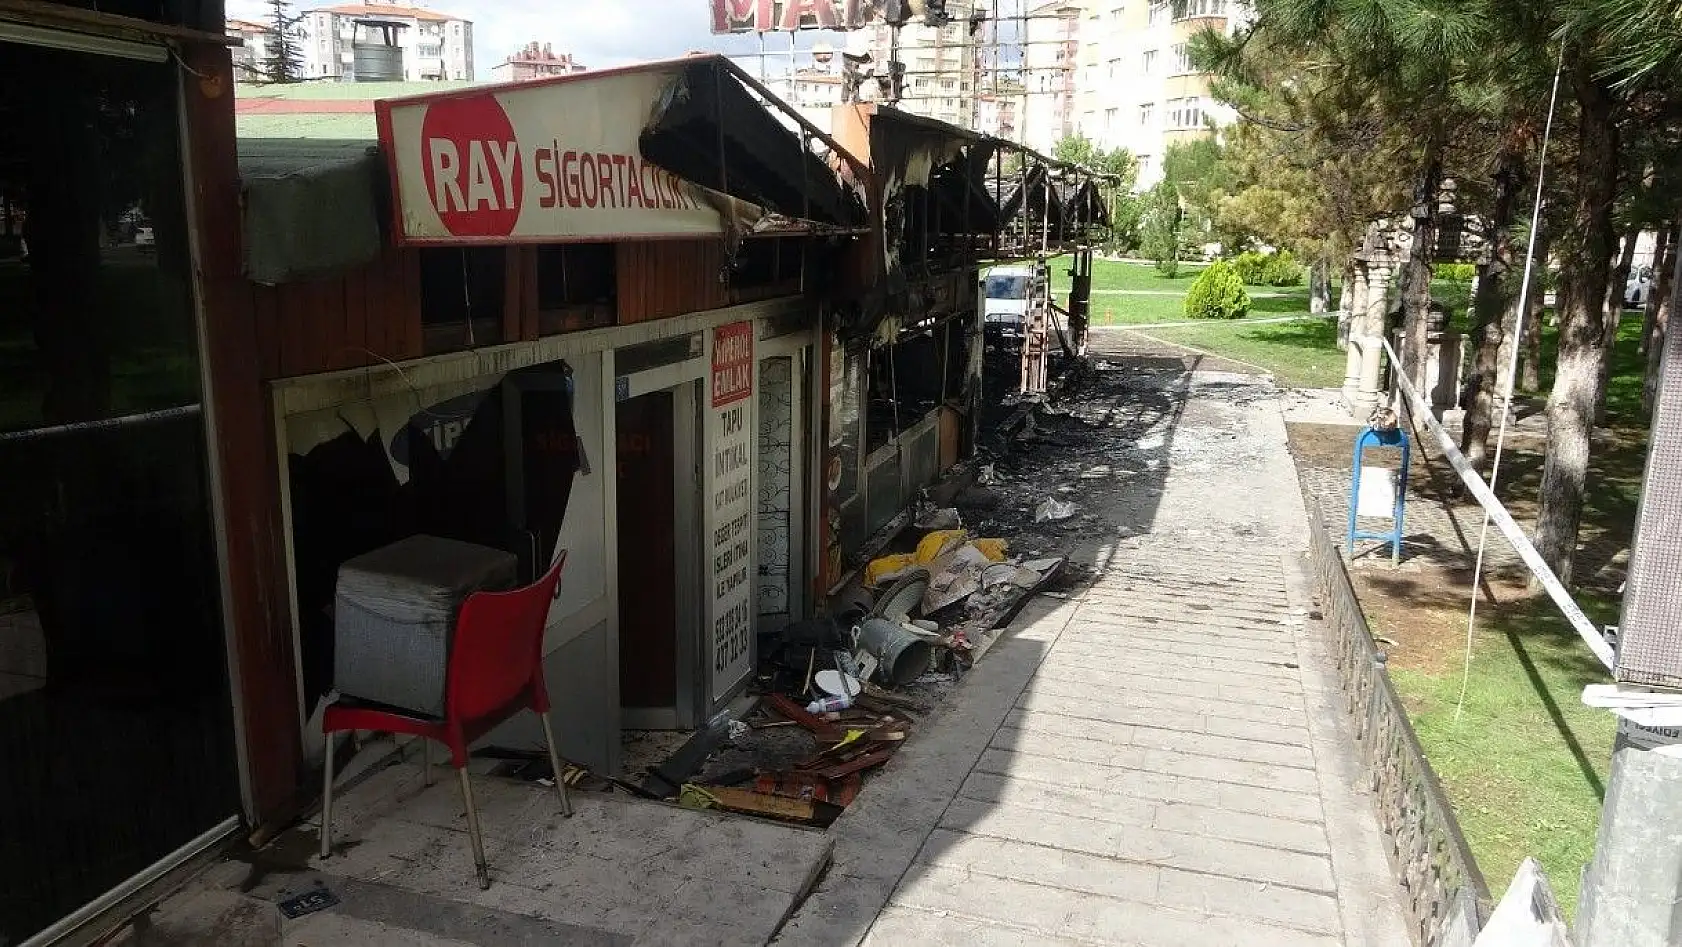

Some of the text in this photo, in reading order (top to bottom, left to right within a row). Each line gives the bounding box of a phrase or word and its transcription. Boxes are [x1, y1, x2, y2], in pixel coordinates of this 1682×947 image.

[429, 136, 518, 212] RAY
[714, 363, 750, 398] EMLAK
[721, 406, 743, 438] TAPU
